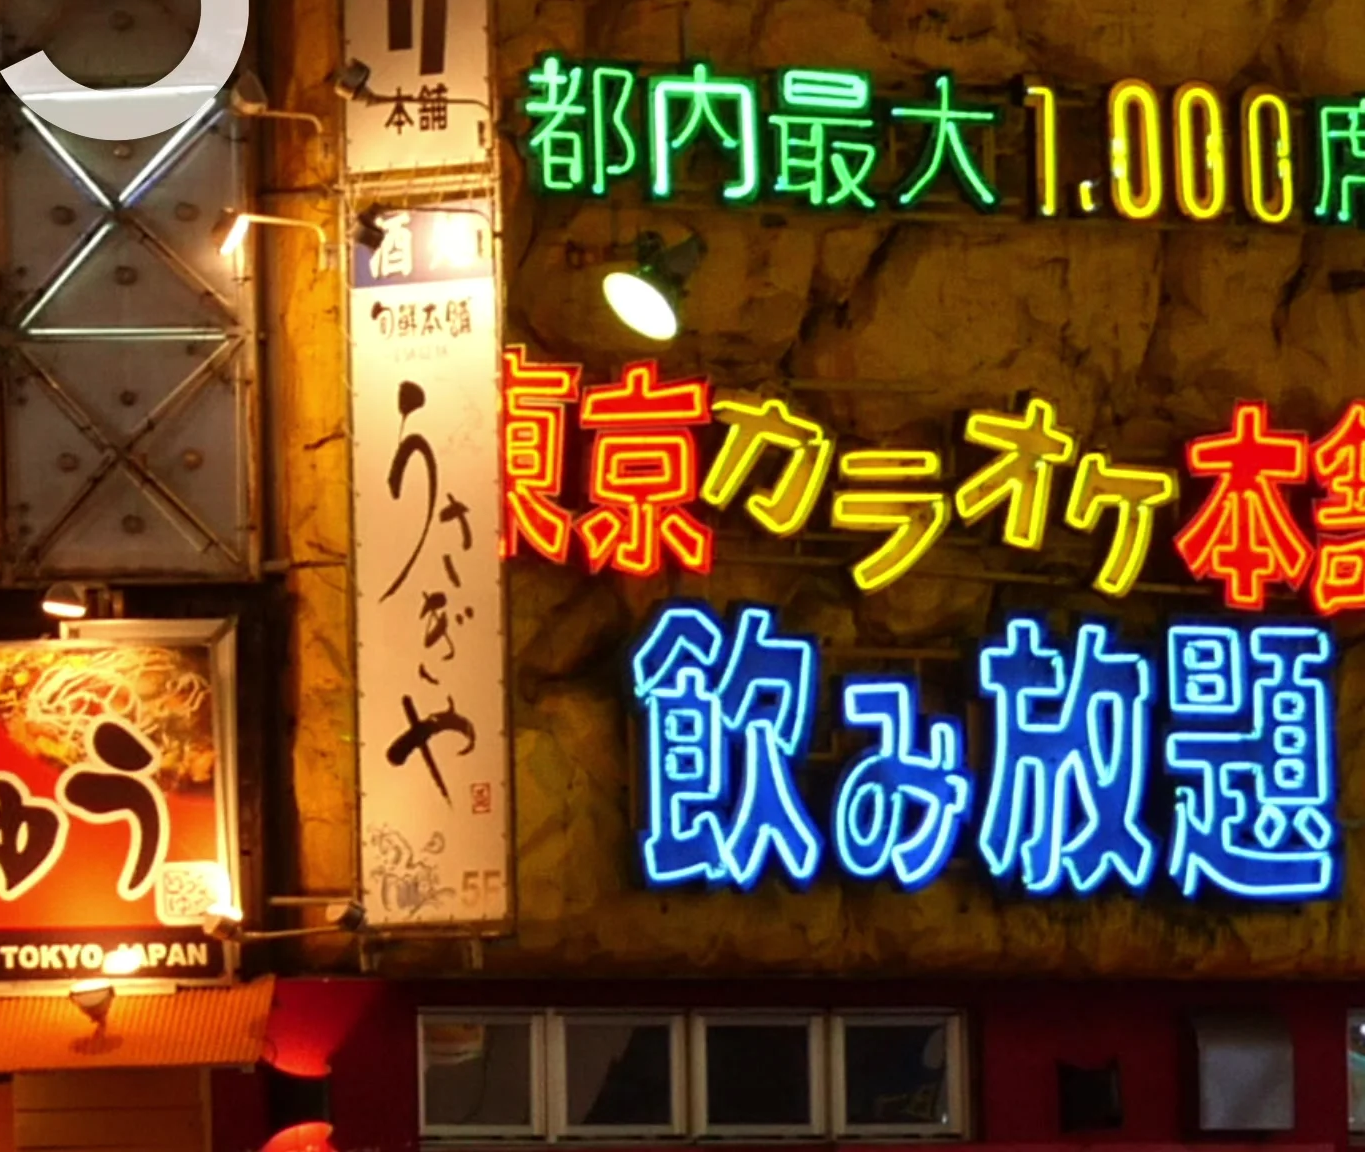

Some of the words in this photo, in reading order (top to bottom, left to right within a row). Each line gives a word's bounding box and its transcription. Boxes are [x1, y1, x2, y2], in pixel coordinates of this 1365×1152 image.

[384, 81, 449, 135] 本舗
[378, 379, 476, 808] うさぎや
[632, 605, 1333, 899] 飲み放題
[461, 870, 501, 907] 5F
[0, 944, 103, 970] TOKYO
